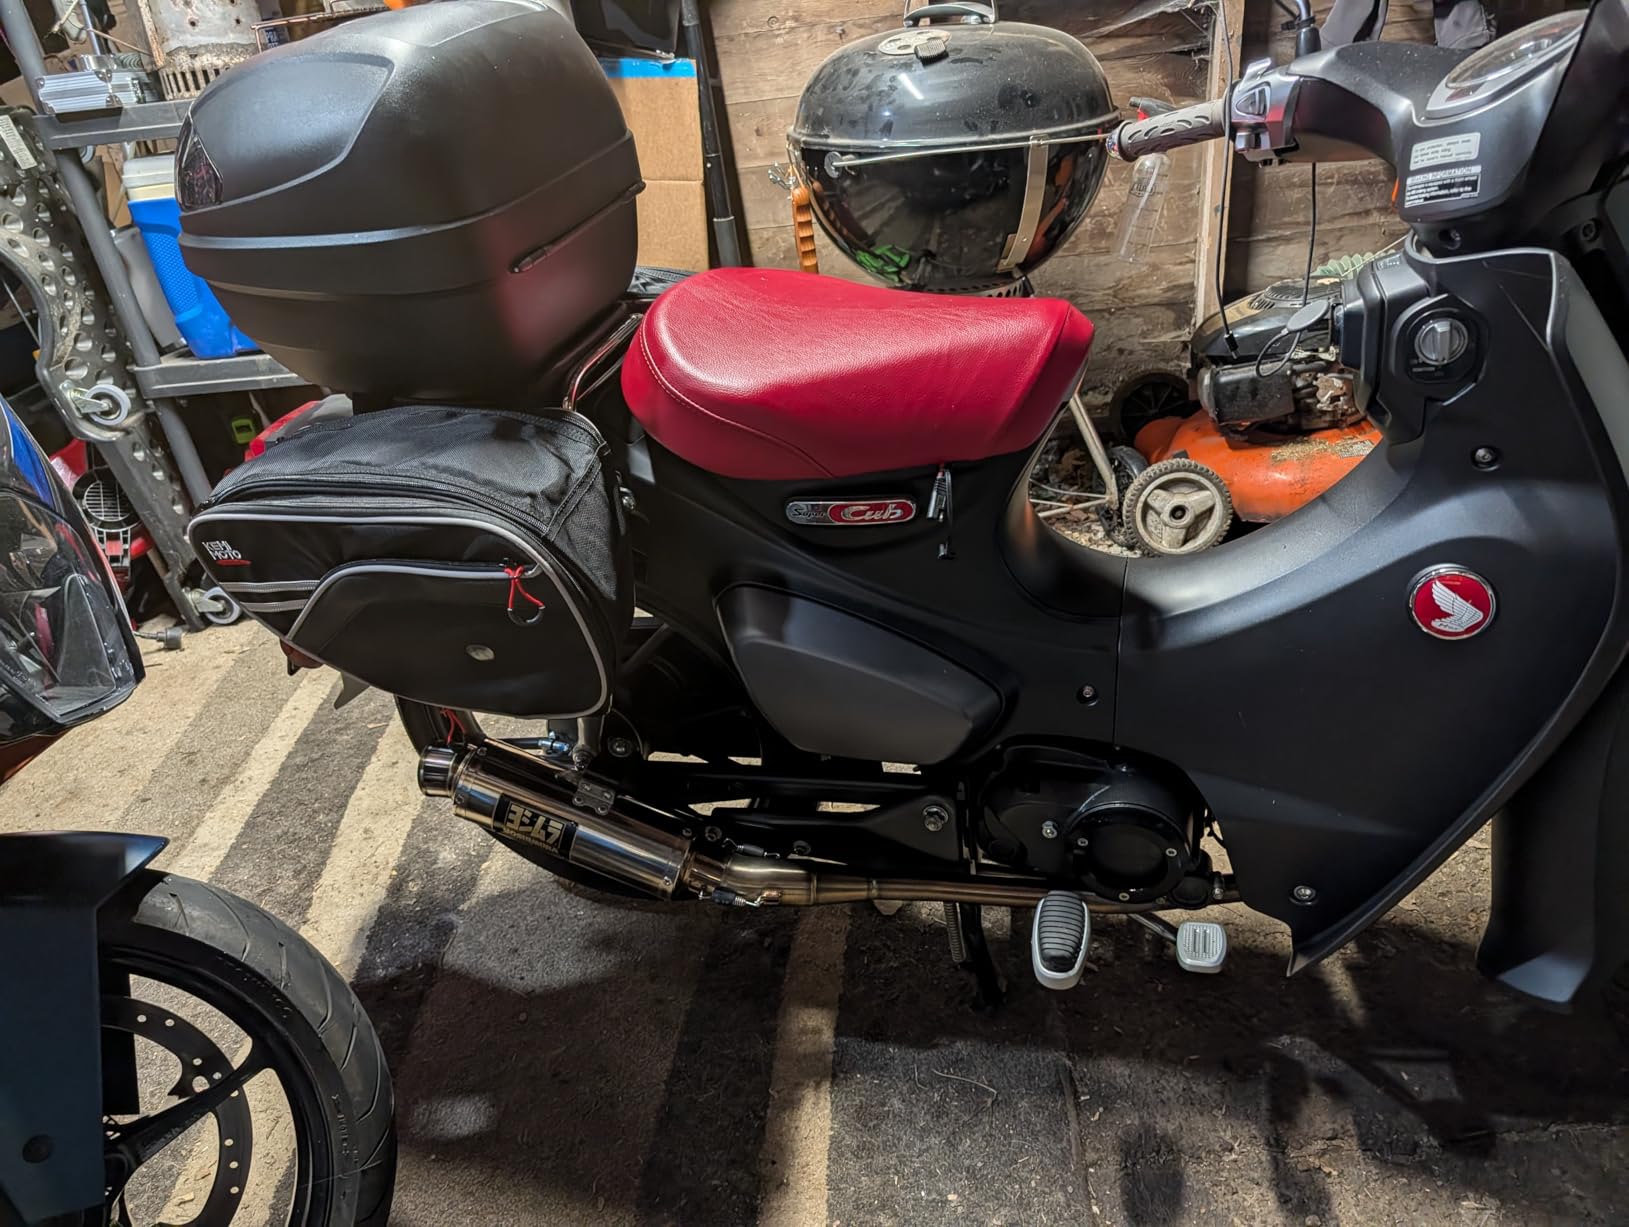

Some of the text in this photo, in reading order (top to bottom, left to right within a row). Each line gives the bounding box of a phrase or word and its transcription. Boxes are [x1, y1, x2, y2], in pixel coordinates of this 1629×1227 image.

[841, 503, 903, 521] Cub
[201, 540, 233, 551] KEMI
[209, 549, 242, 560] MOTO
[505, 804, 563, 846] ヨシムラ
